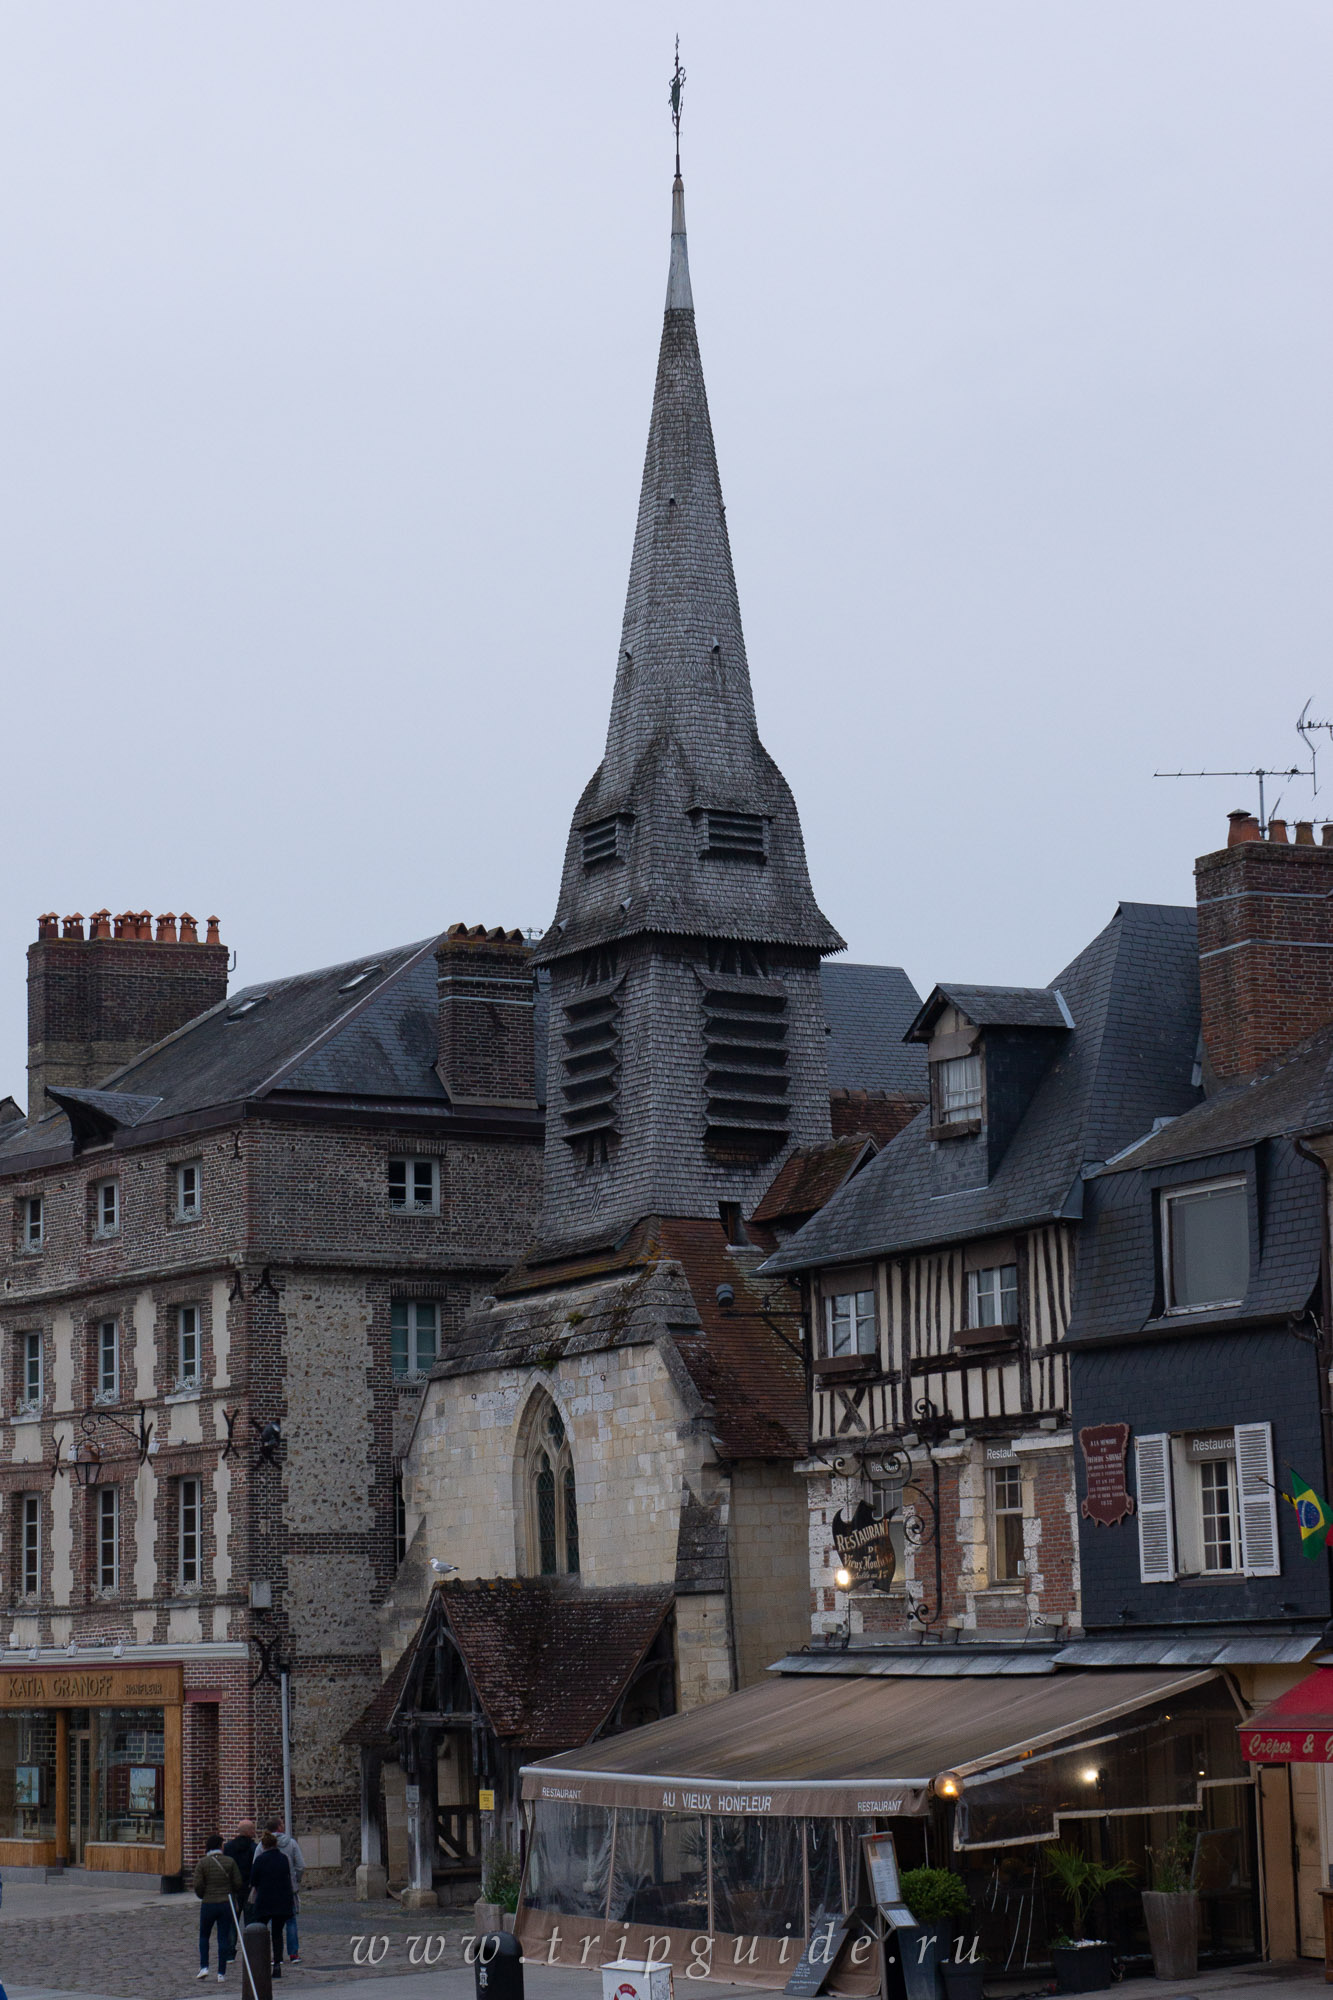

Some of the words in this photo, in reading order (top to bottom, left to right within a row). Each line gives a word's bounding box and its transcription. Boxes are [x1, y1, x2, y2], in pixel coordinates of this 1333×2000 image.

[9, 1677, 45, 1698] KATIA
[53, 1675, 113, 1697] GRANOFF
[125, 1682, 163, 1696] HONFLEUR
[1249, 1733, 1292, 1758] Crêpes
[1302, 1733, 1315, 1754] &
[542, 1786, 582, 1799] RESTAURANT
[662, 1791, 676, 1808] AU
[682, 1793, 712, 1810] VIEUX
[718, 1795, 772, 1812] HONFLEUR
[857, 1800, 903, 1812] RESTAURANT
